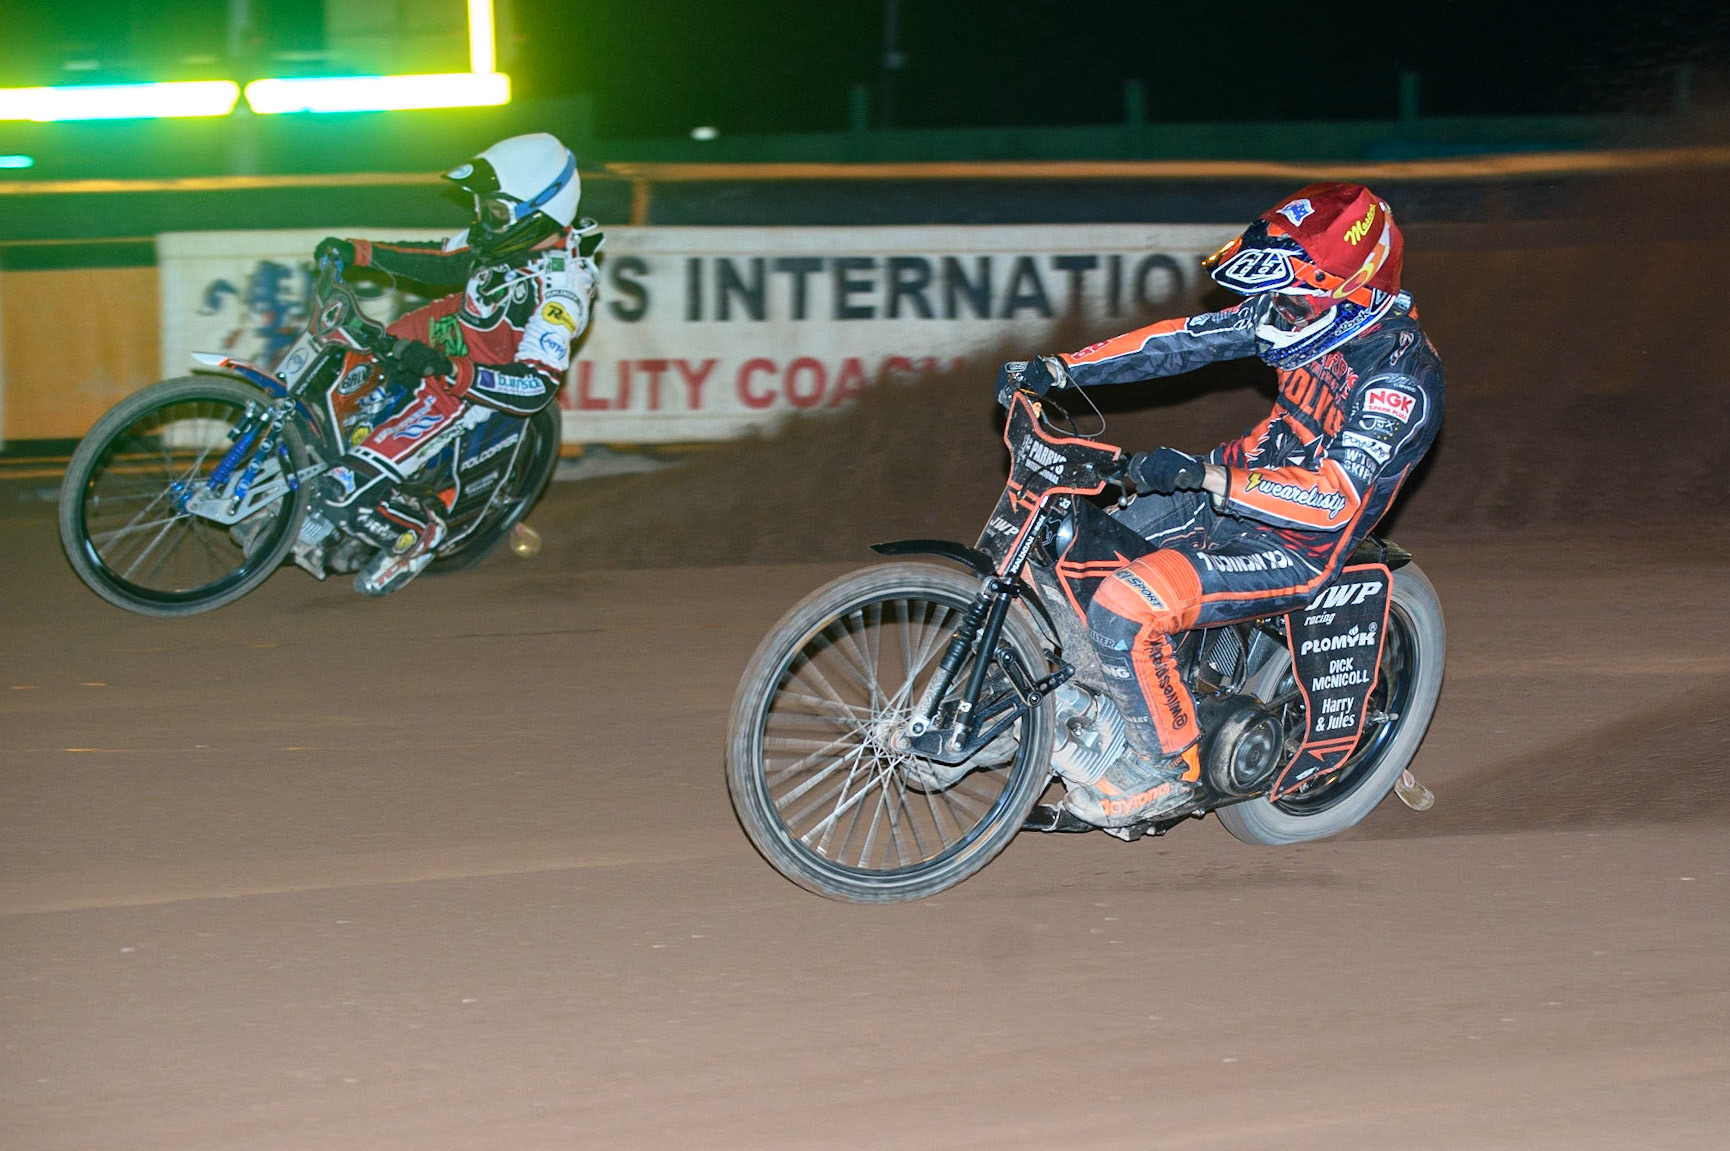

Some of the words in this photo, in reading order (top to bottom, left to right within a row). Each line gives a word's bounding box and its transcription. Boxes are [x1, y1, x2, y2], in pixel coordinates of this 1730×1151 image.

[686, 254, 1203, 322] INTERNATIO
[558, 359, 717, 411] LITY
[735, 355, 967, 410] COA
[1369, 391, 1413, 414] NGK
[1028, 440, 1068, 475] PARRYS
[989, 517, 1020, 537] JWP
[1304, 581, 1384, 611] JWP
[1304, 611, 1336, 626] racing
[1301, 628, 1377, 655] PLOMYK
[1329, 657, 1354, 674] DICK
[1312, 669, 1370, 692] MCNICOLL
[1321, 697, 1354, 714] Harry
[1315, 718, 1325, 732] &
[1327, 712, 1355, 730] Jules
